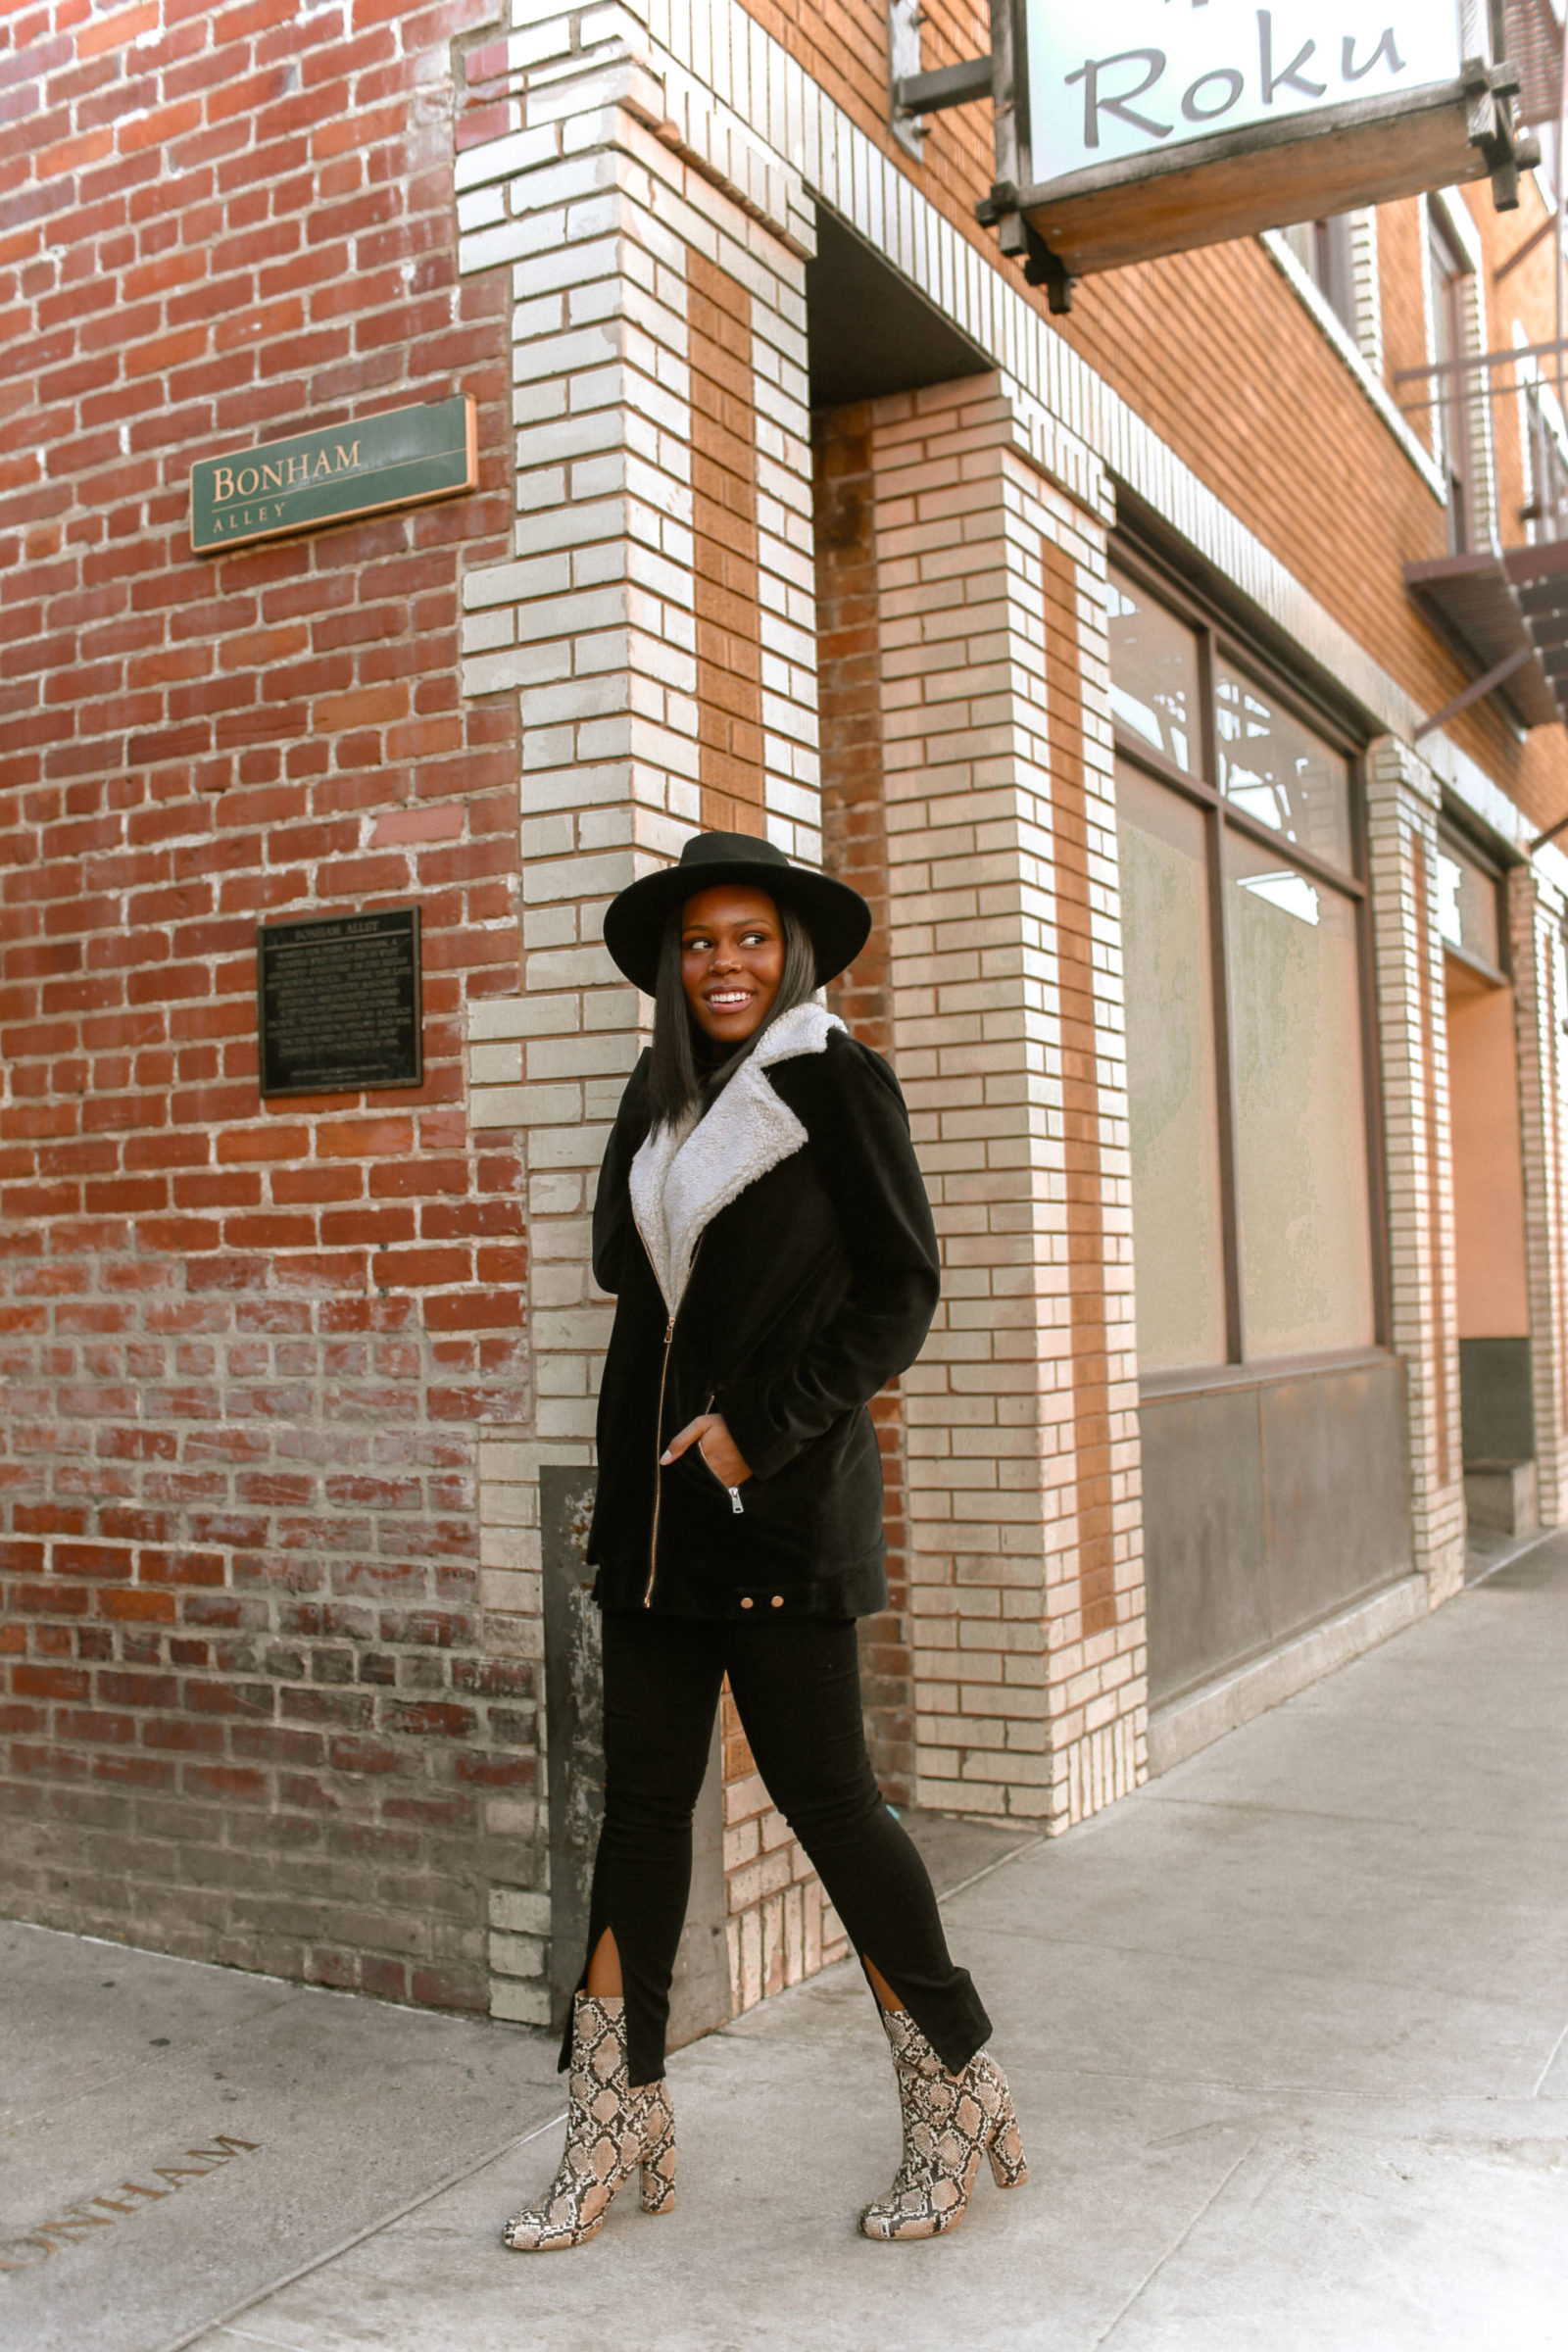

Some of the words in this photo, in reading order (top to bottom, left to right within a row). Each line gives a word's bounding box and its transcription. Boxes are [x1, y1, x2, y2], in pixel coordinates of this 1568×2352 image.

[1064, 9, 1407, 148] Roku
[213, 440, 362, 503] BONHAM
[213, 502, 286, 533] ALLEY
[346, 920, 380, 935] ALLEY
